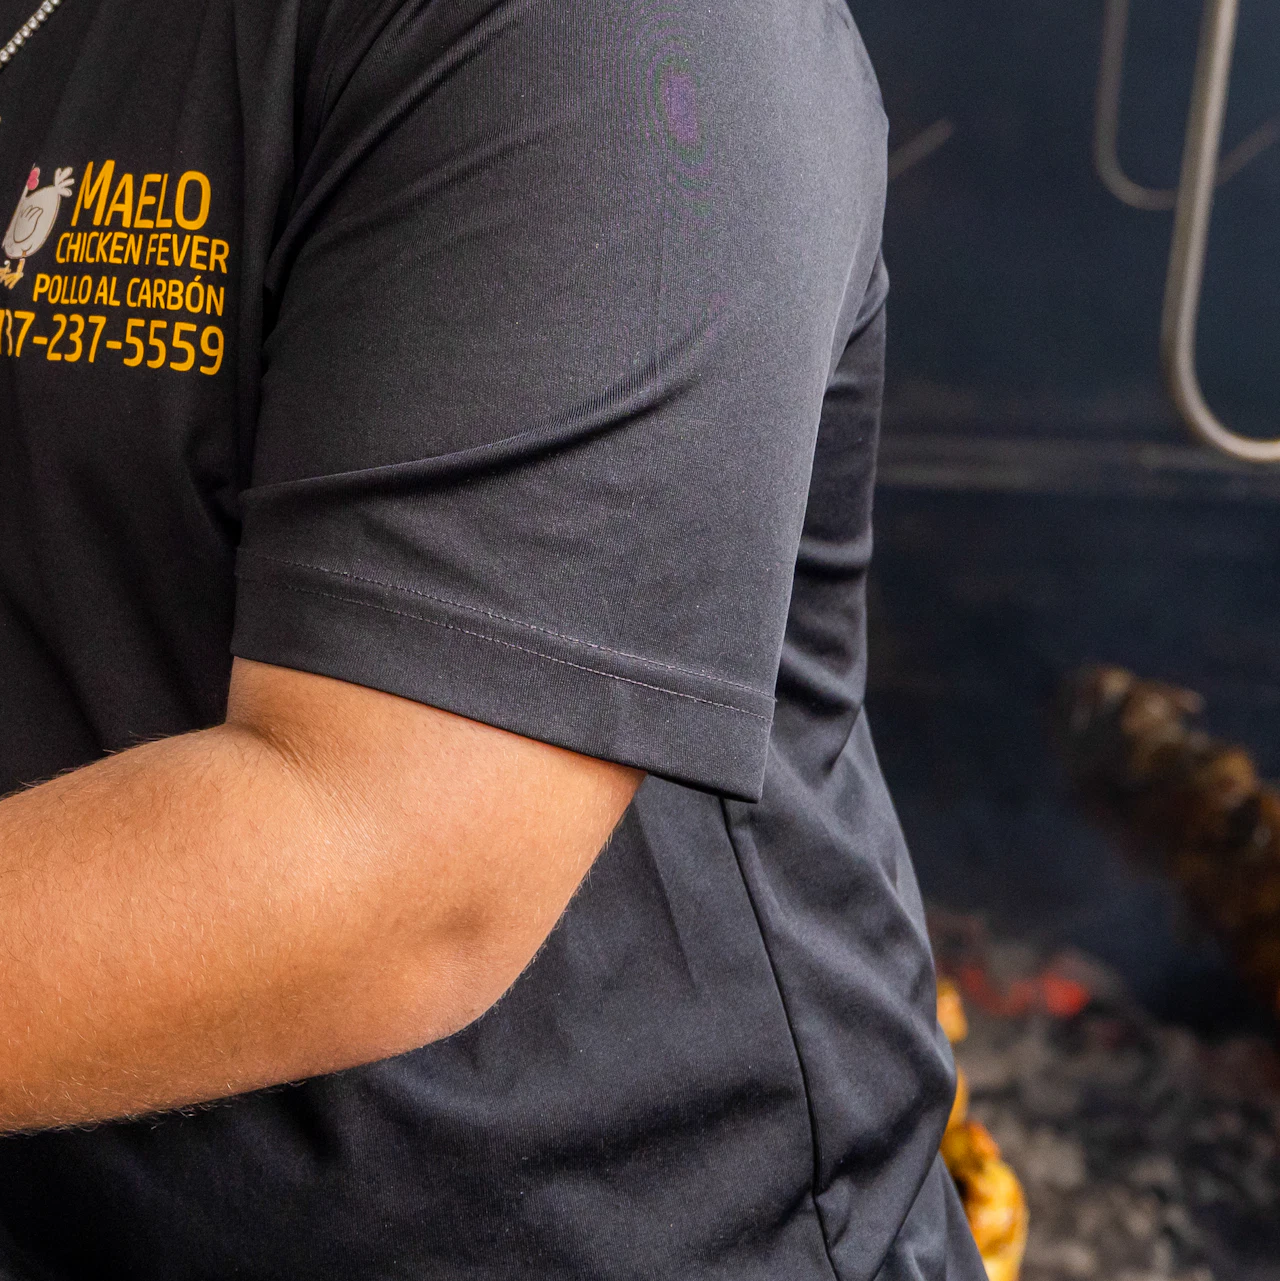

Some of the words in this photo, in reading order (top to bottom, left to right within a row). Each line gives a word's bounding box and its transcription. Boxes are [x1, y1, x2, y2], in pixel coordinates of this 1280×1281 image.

[70, 159, 212, 231] MAELO
[55, 231, 144, 266] CHICKEN
[144, 232, 230, 274] FEVER
[32, 273, 93, 305] POLLO
[93, 276, 122, 307] AL
[126, 274, 225, 317] CARBÓN
